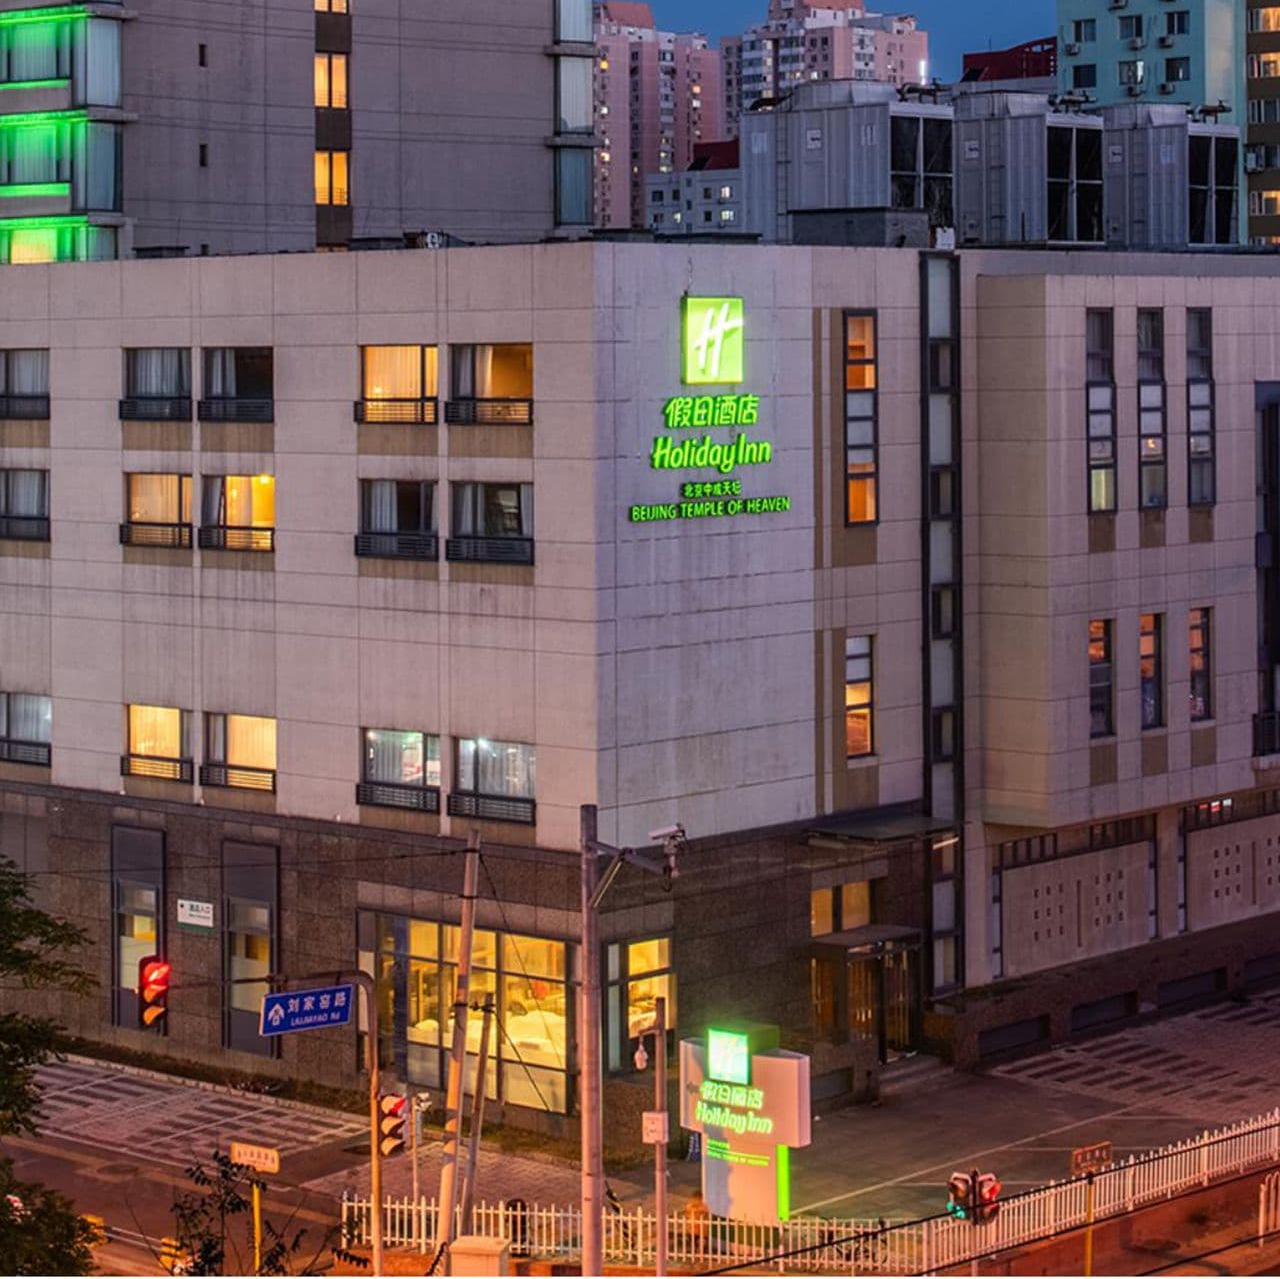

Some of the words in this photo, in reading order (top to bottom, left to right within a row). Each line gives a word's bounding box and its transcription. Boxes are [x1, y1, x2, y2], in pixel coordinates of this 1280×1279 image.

[664, 393, 760, 428] 假日酒店
[652, 435, 736, 473] Holiday
[737, 432, 772, 465] Inn
[631, 503, 677, 521] BEIJING
[680, 501, 724, 518] TEMPLE
[727, 499, 743, 516] OF
[746, 496, 791, 514] HEAVEN
[695, 1100, 747, 1135] Holiday
[747, 1110, 773, 1135] Inn
